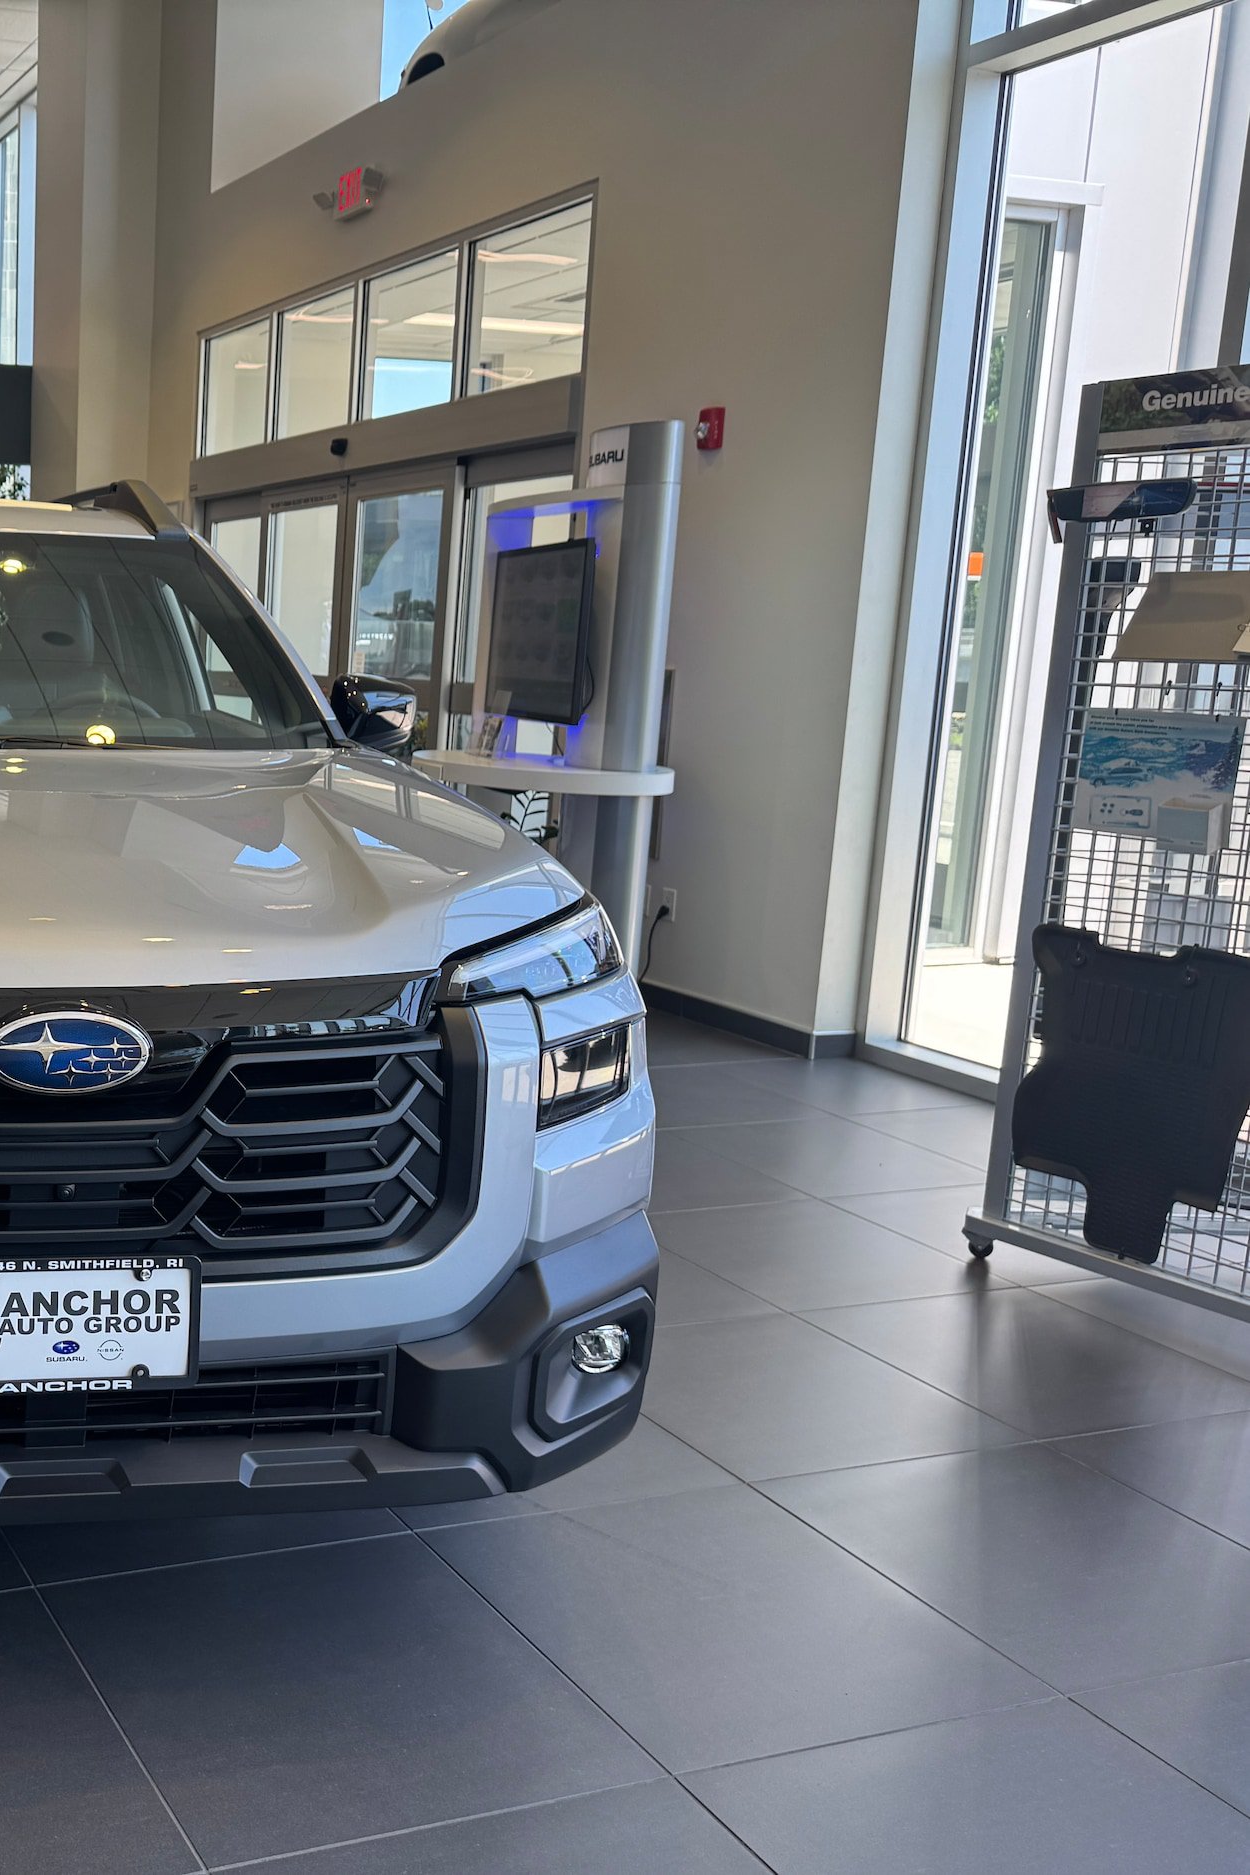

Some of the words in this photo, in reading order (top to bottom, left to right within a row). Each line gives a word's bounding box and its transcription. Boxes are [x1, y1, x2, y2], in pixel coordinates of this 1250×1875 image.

[338, 166, 363, 212] EXIT
[1142, 384, 1250, 412] Genuine
[22, 1261, 42, 1270] N.
[166, 1258, 183, 1267] RI
[1, 1289, 180, 1316] ANCHOR
[83, 1315, 181, 1334] GROUP
